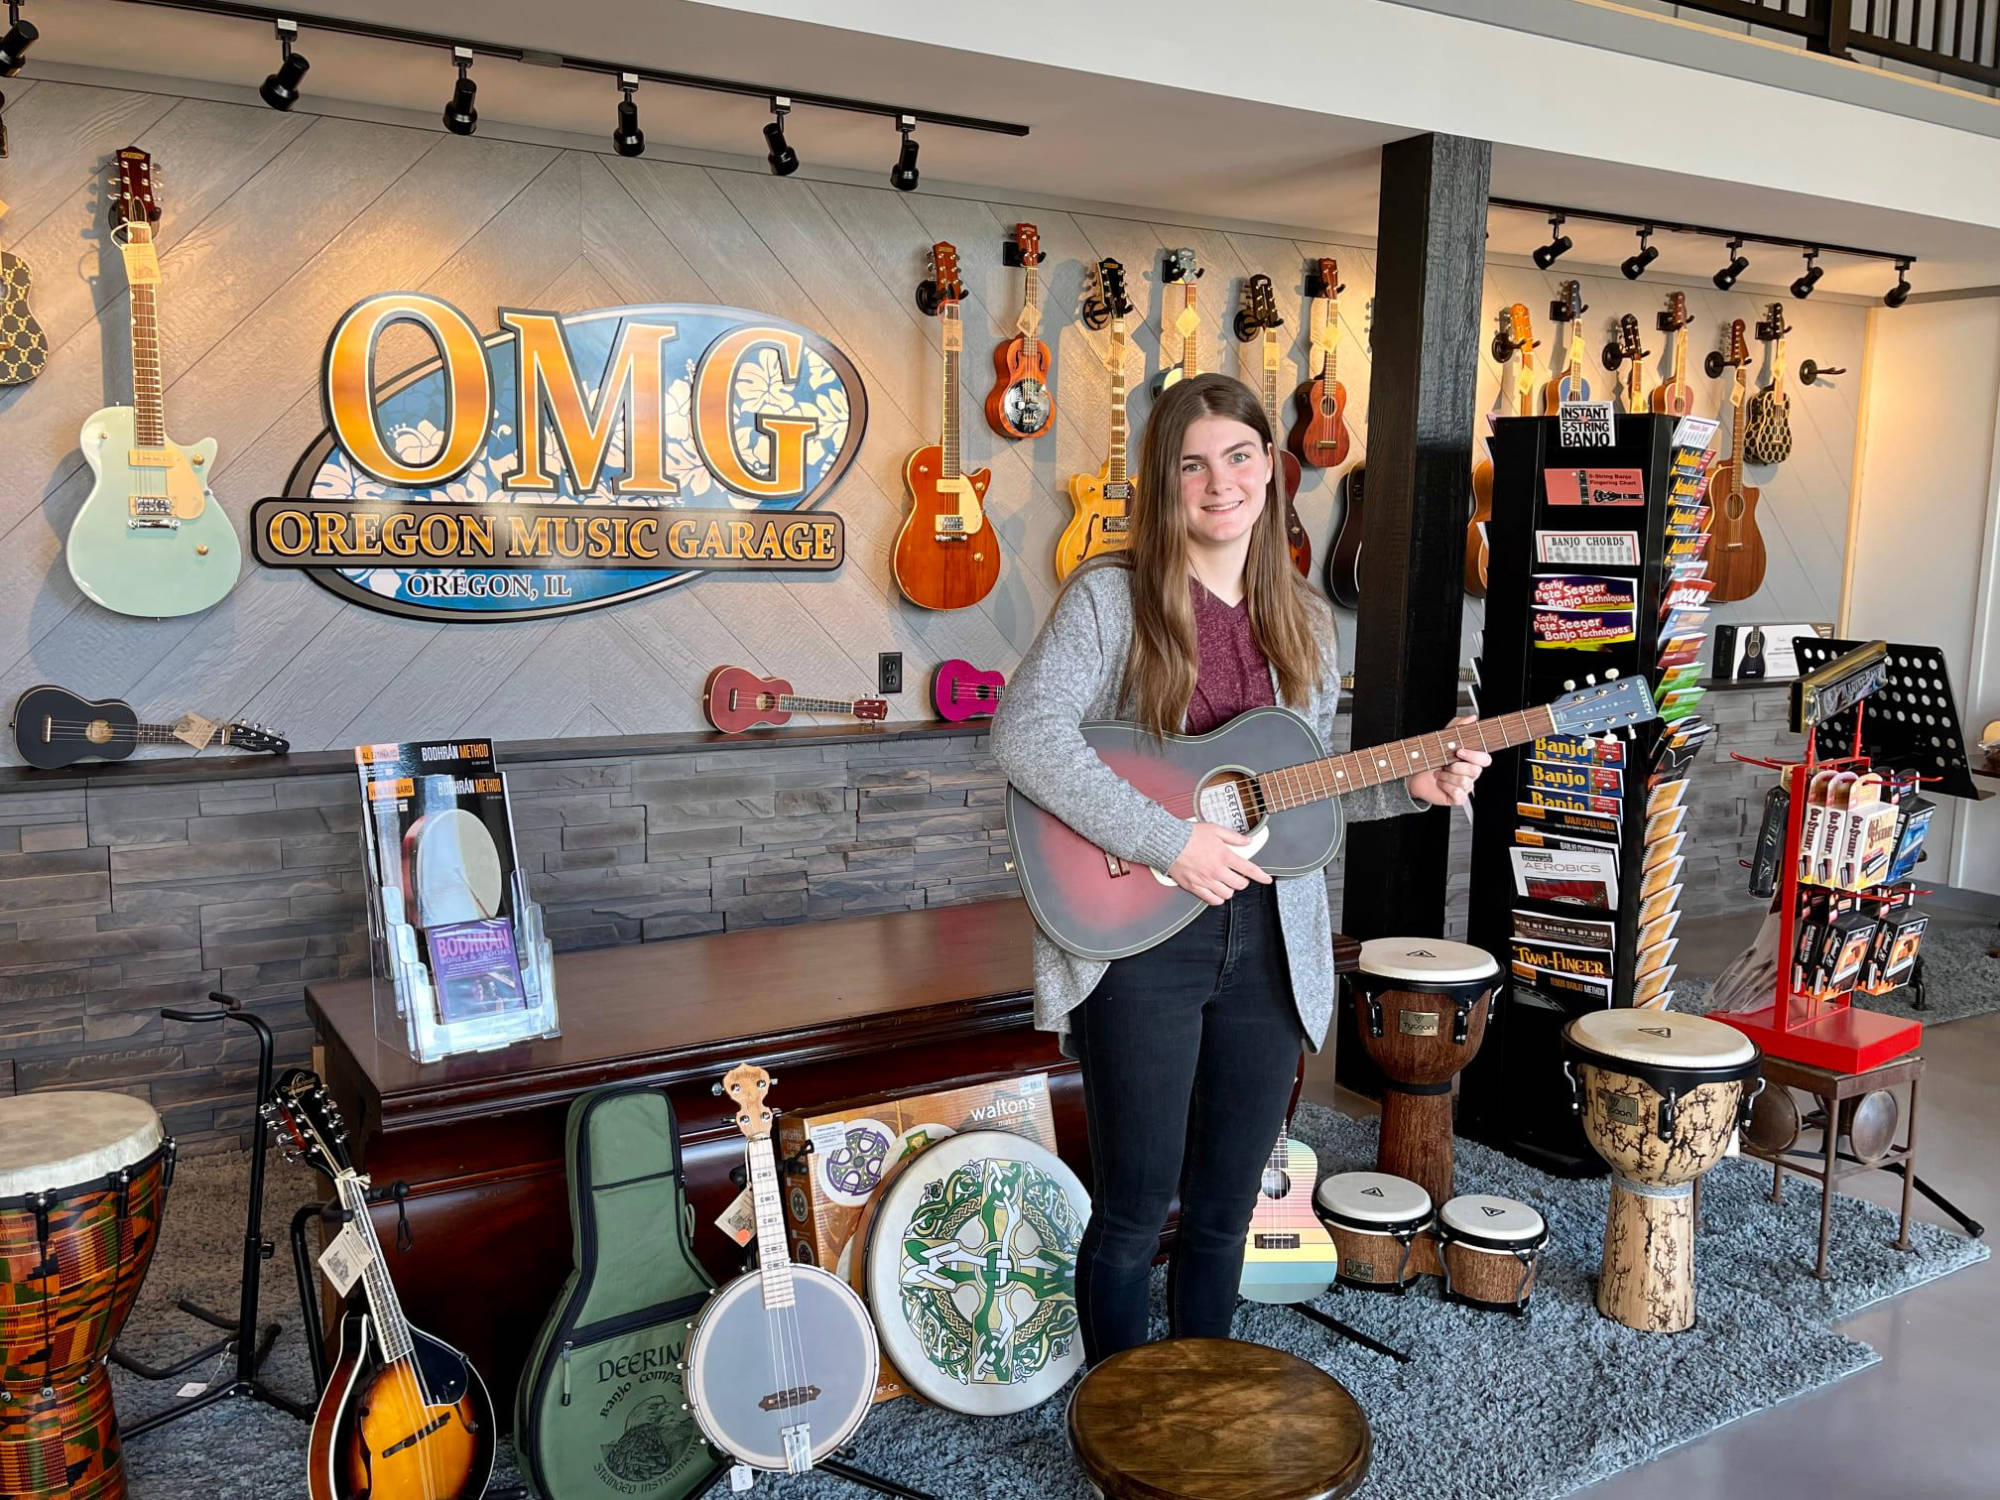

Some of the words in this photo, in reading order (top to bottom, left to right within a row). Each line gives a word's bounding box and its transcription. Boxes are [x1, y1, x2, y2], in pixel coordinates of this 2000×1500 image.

[324, 292, 817, 497] OMG
[1561, 407, 1608, 419] INSTANT
[1562, 421, 1609, 432] 5-STRING
[1562, 432, 1610, 447] BANJO
[268, 511, 496, 558] OREGON
[507, 514, 659, 560] MUSIC
[665, 519, 837, 563] GARAGE
[1551, 537, 1580, 548] BANJO
[1586, 537, 1625, 546] CHORDS
[406, 571, 538, 600] OREGON,
[542, 573, 572, 598] IL
[1534, 590, 1561, 602] Pete
[1563, 583, 1607, 597] Seeger
[1538, 579, 1564, 591] Early
[1547, 596, 1582, 609] Banjo
[1583, 593, 1632, 604] Techniques
[1533, 620, 1557, 632] Pete
[1558, 617, 1602, 630] Seeger
[1536, 613, 1558, 623] Early
[1544, 630, 1577, 642] Banjo
[1578, 625, 1631, 638] Techniques
[421, 743, 459, 761] BODHRÁN
[459, 743, 489, 759] METHOD
[1535, 736, 1588, 758] Banjo
[1531, 764, 1586, 787] Banjo
[438, 777, 475, 796] BODHRÁN
[475, 778, 501, 793] METHOD
[1531, 791, 1585, 811] Banjo
[1523, 862, 1602, 873] AEROBICS
[1403, 1022, 1435, 1032] Tycoon
[970, 1097, 1036, 1121] waltons
[597, 1341, 685, 1384] DEERIN
[639, 1370, 683, 1385] compa
